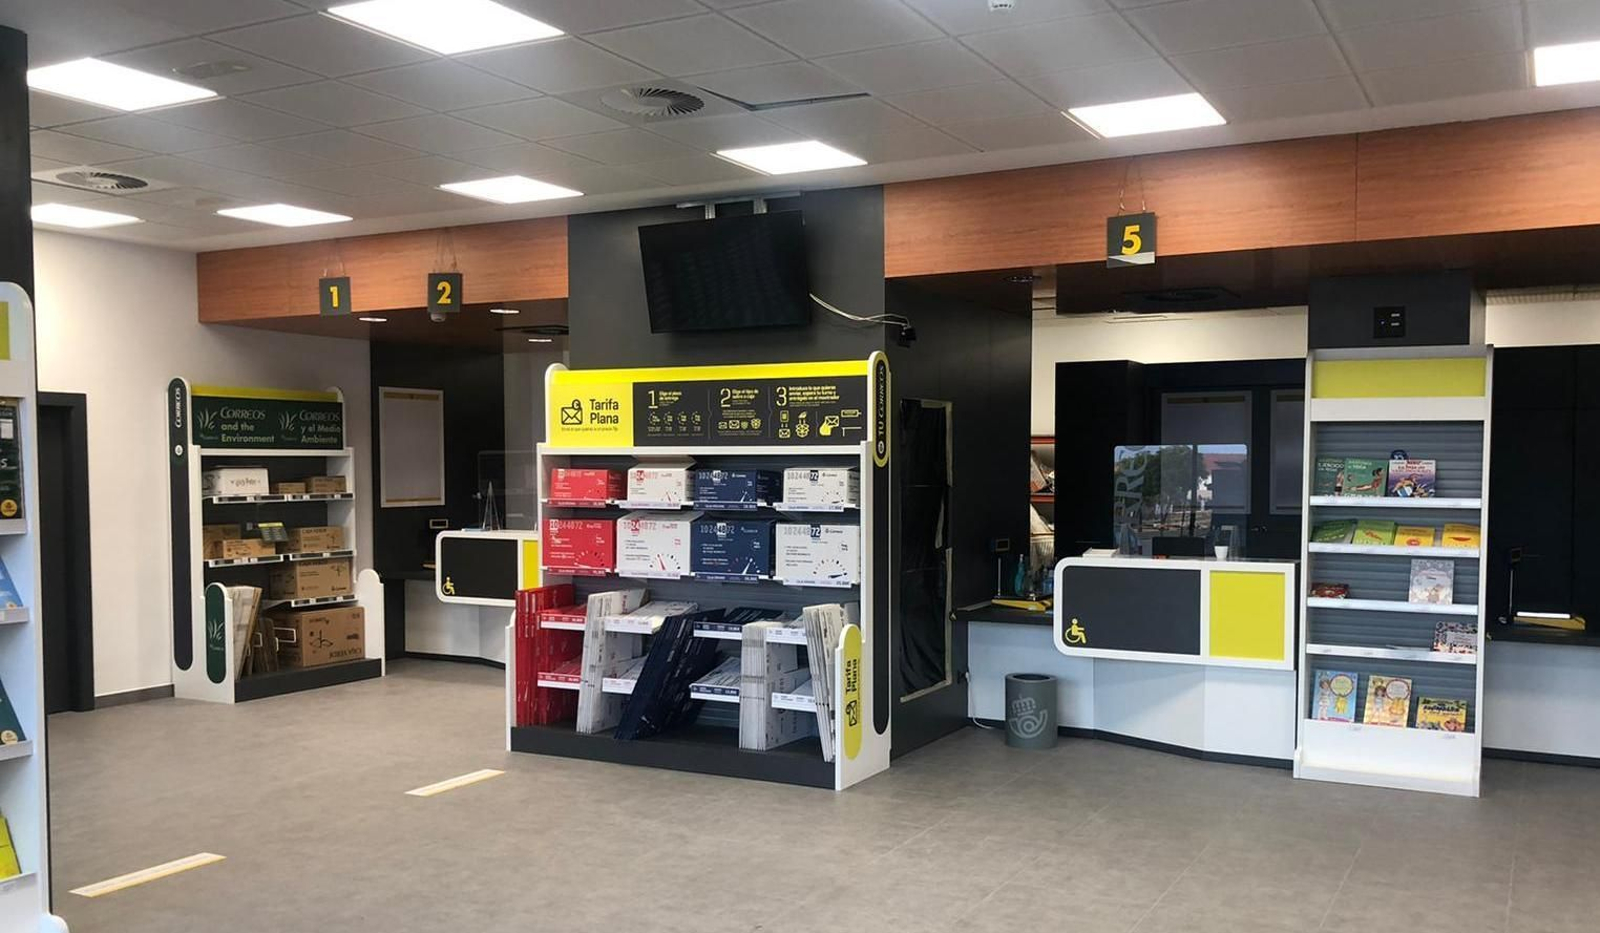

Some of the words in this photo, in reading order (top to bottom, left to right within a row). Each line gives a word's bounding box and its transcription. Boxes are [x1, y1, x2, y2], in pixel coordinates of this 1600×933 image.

[1121, 224, 1142, 255] 5
[329, 285, 340, 308] 1
[436, 281, 451, 304] 2
[648, 390, 658, 409] 1
[720, 388, 731, 408] 2
[776, 386, 787, 407] 3
[589, 399, 619, 411] Tarifa
[220, 406, 267, 419] CORREOS
[590, 412, 619, 424] Plana
[221, 423, 238, 431] and
[241, 422, 254, 431] the
[308, 424, 316, 432] el
[317, 424, 341, 432] Medio
[221, 433, 274, 443] Environment
[301, 435, 337, 443] Ambiente
